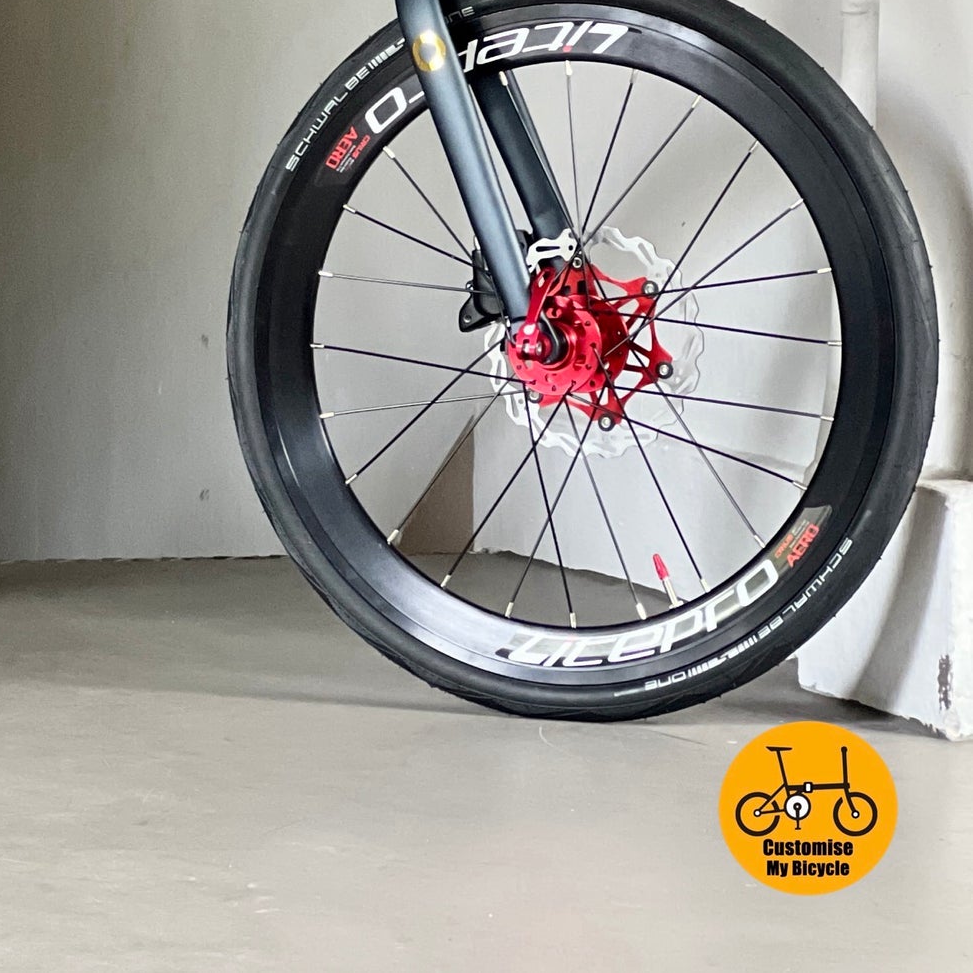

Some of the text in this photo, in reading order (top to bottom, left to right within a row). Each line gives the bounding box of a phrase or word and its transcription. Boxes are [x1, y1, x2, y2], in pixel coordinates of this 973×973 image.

[285, 65, 371, 172] SCHWALBE
[325, 126, 359, 170] AERO
[787, 523, 820, 568] AERO
[757, 537, 853, 640] SCHWALBE
